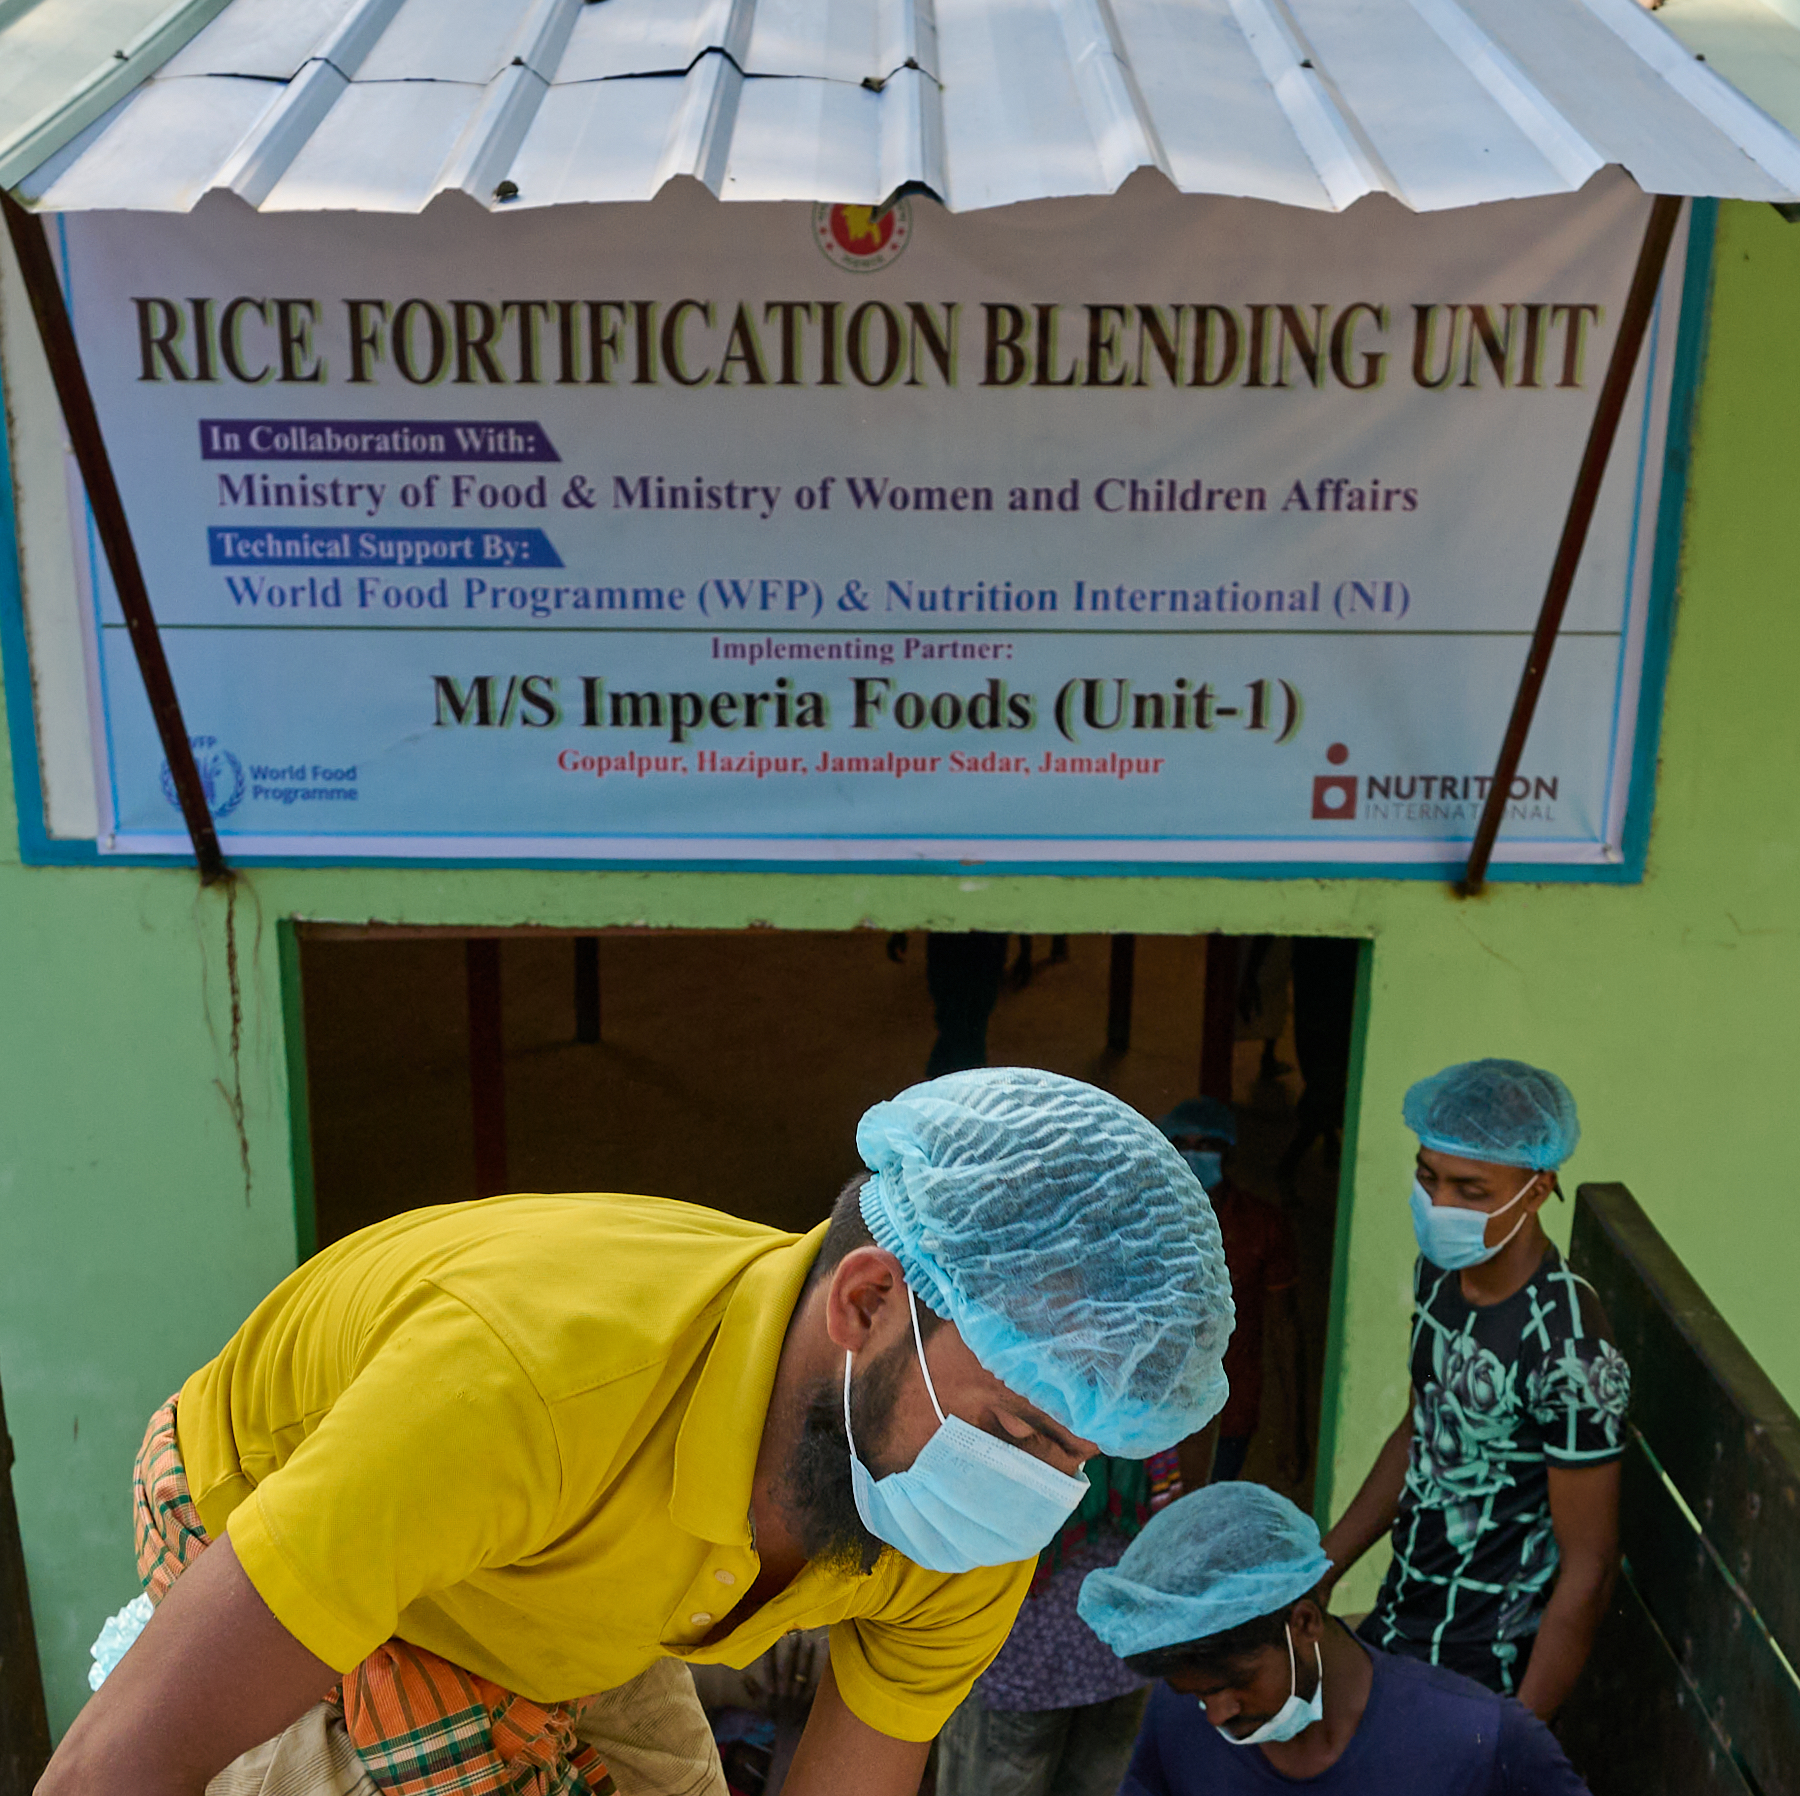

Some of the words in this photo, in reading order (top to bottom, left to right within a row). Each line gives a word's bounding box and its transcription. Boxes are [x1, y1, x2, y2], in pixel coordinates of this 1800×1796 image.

[130, 296, 324, 385] RICE
[342, 298, 960, 388] FORTIFICATION
[979, 301, 1389, 389] BLENDING
[1410, 302, 1599, 389] UNIT
[210, 425, 241, 453] In
[248, 425, 446, 455] Collaboration
[453, 426, 536, 455] With:
[217, 472, 387, 516] Ministry
[400, 473, 440, 509] of
[450, 475, 548, 510] Food
[562, 476, 597, 511] &
[611, 475, 782, 518] Ministry
[795, 476, 837, 512] of
[844, 477, 994, 513] Women
[1008, 478, 1081, 513] and
[1093, 478, 1268, 514] Children
[1281, 478, 1420, 514] Affairs
[217, 533, 352, 561] Technical
[358, 534, 475, 565] Support
[482, 536, 531, 566] By:
[225, 576, 343, 611] World
[357, 577, 449, 612] Food
[463, 578, 687, 620] Programme
[697, 578, 825, 620] (WFP)
[836, 580, 870, 613] &
[884, 579, 1059, 614] Nutrition
[1072, 580, 1321, 615] International
[1333, 580, 1412, 620] (NI)
[711, 637, 895, 667] Implementing
[904, 637, 1014, 662] Partner:
[431, 675, 560, 730] M/S
[579, 675, 829, 744] Imperia
[849, 677, 1035, 732] Foods
[1053, 677, 1302, 743] (Unit-1)
[250, 765, 307, 782] World
[312, 765, 358, 782] Food
[557, 749, 690, 778] Gopalpur,
[697, 750, 808, 778] Hazipur,
[816, 751, 942, 779] Jamalpur
[949, 751, 1031, 776] Sadar,
[1039, 751, 1165, 777] Jamalpur
[252, 785, 359, 805] Programme
[1367, 776, 1559, 800] NUTRITON
[1365, 802, 1556, 821] INTERNATNAL
